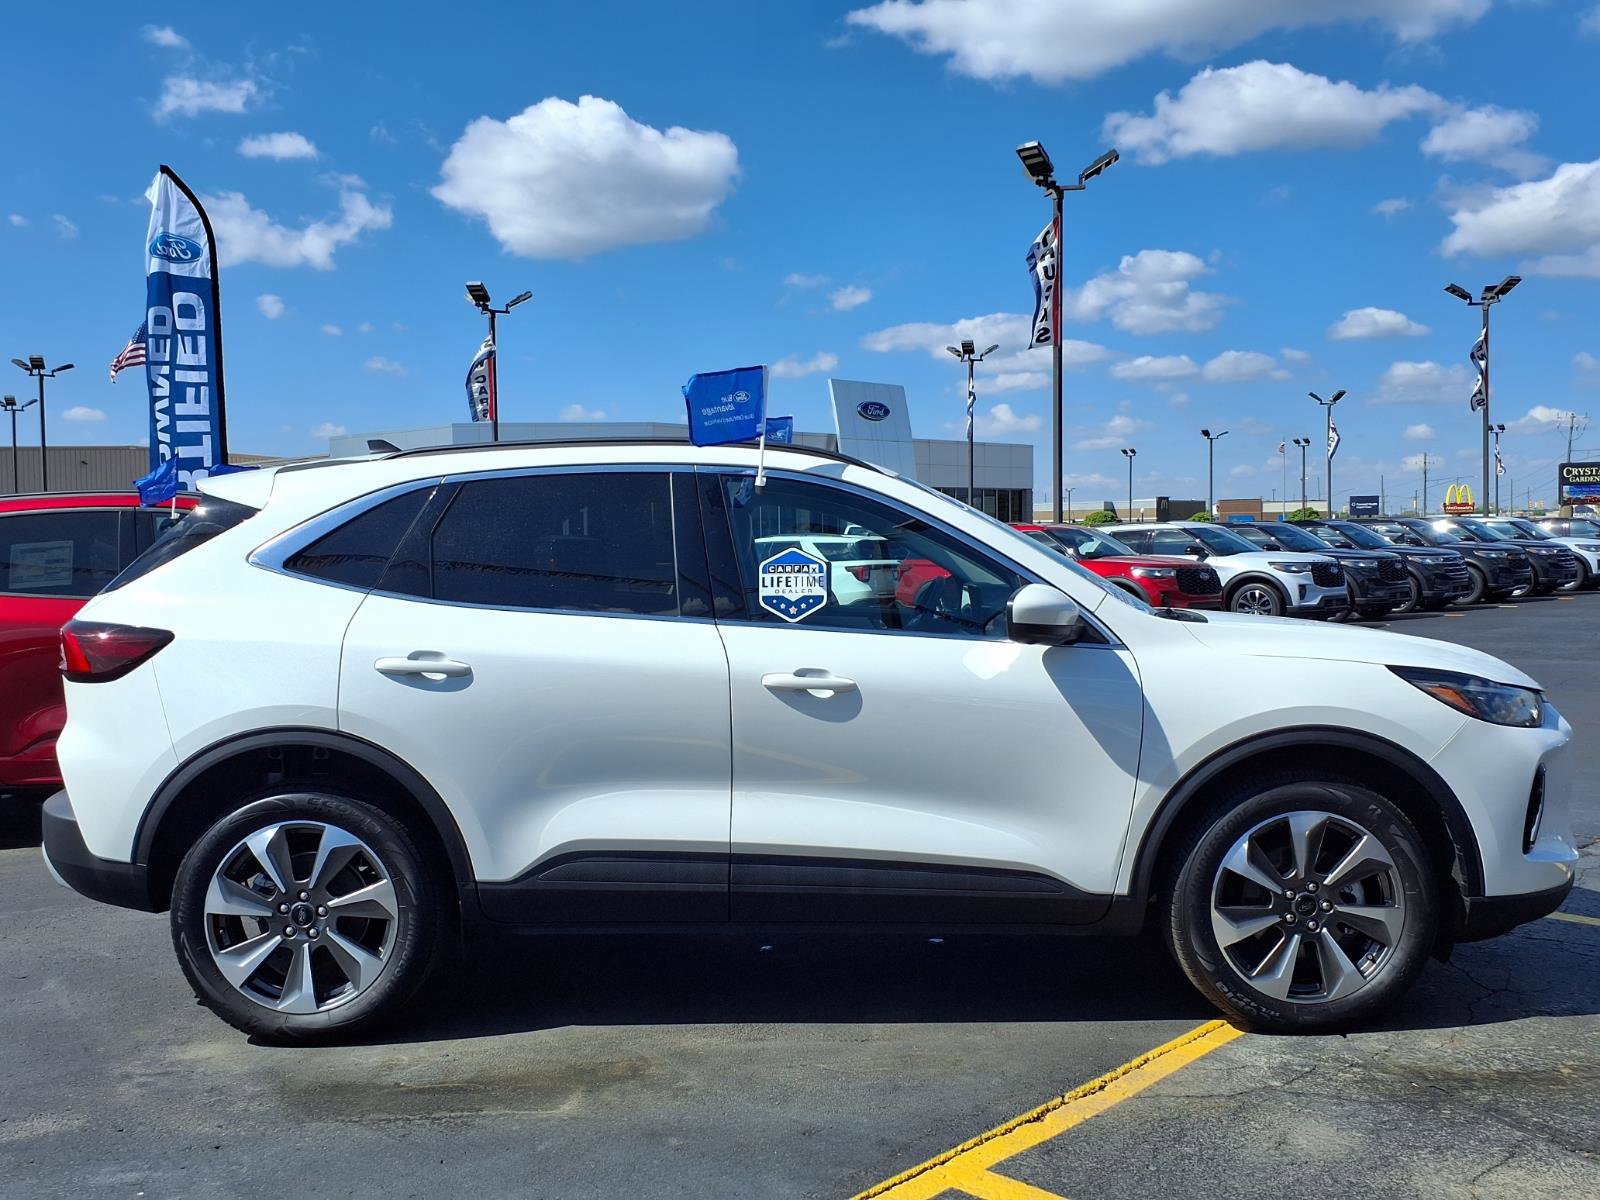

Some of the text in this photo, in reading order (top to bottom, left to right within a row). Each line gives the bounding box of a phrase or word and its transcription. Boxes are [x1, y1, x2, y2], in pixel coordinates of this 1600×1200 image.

[867, 404, 885, 416] Ford
[768, 565, 817, 574] CARFAX
[762, 576, 824, 588] LIFETIME
